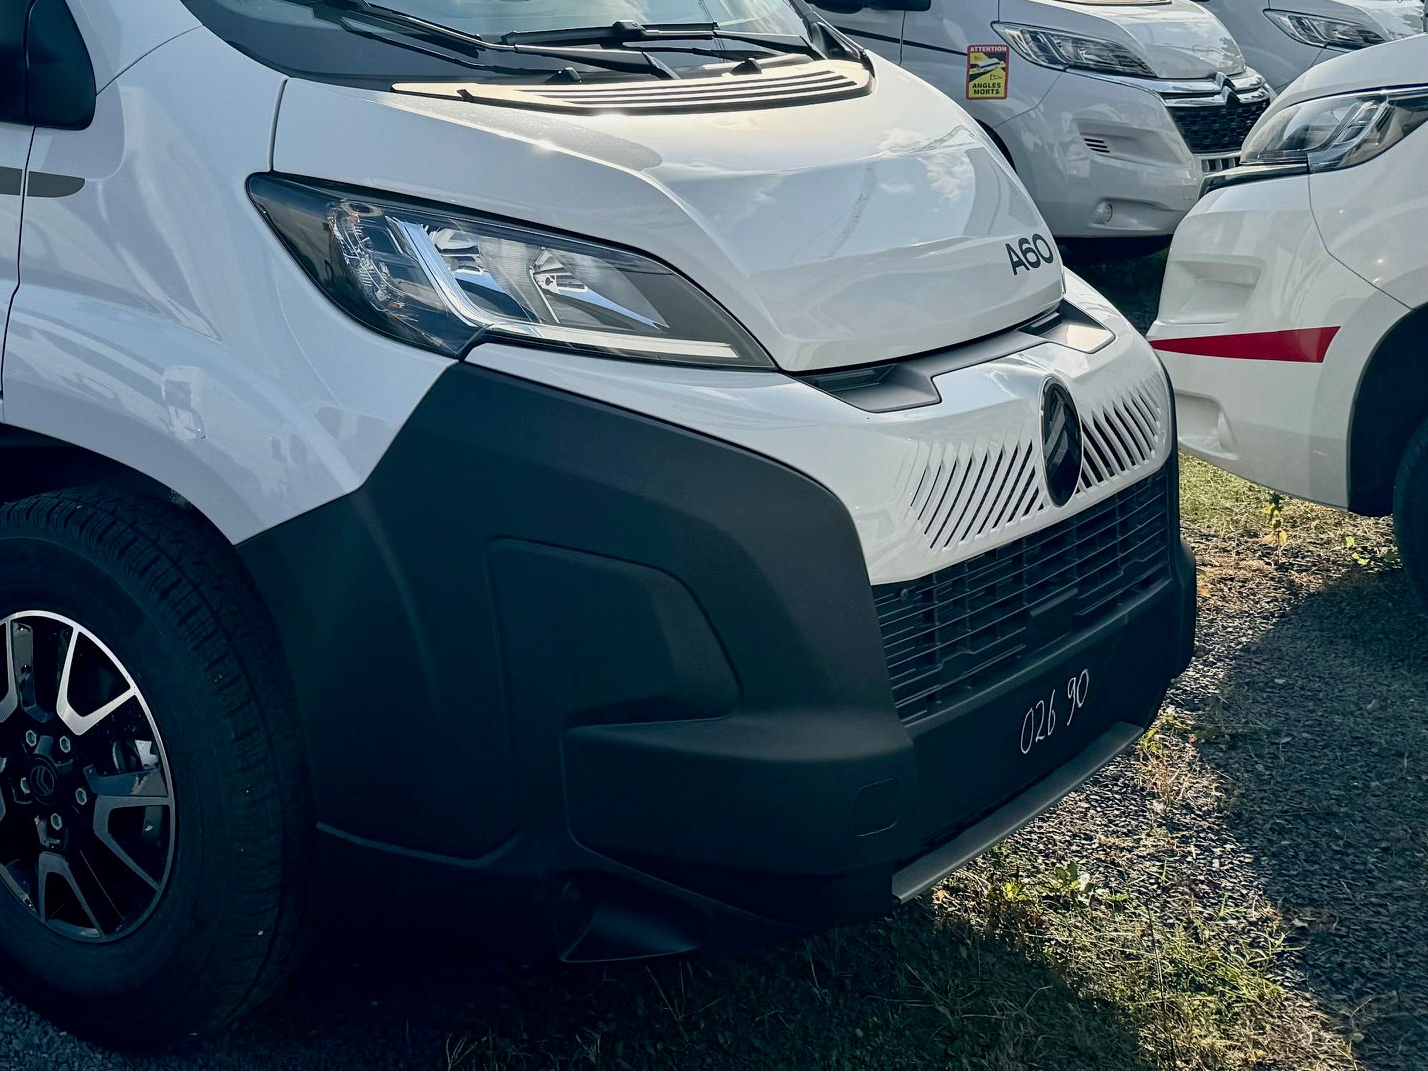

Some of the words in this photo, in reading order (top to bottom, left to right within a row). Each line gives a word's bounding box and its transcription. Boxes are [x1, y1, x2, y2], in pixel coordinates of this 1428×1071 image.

[1005, 233, 1053, 276] A60
[1020, 689, 1056, 754] 026
[1066, 668, 1089, 726] 90
